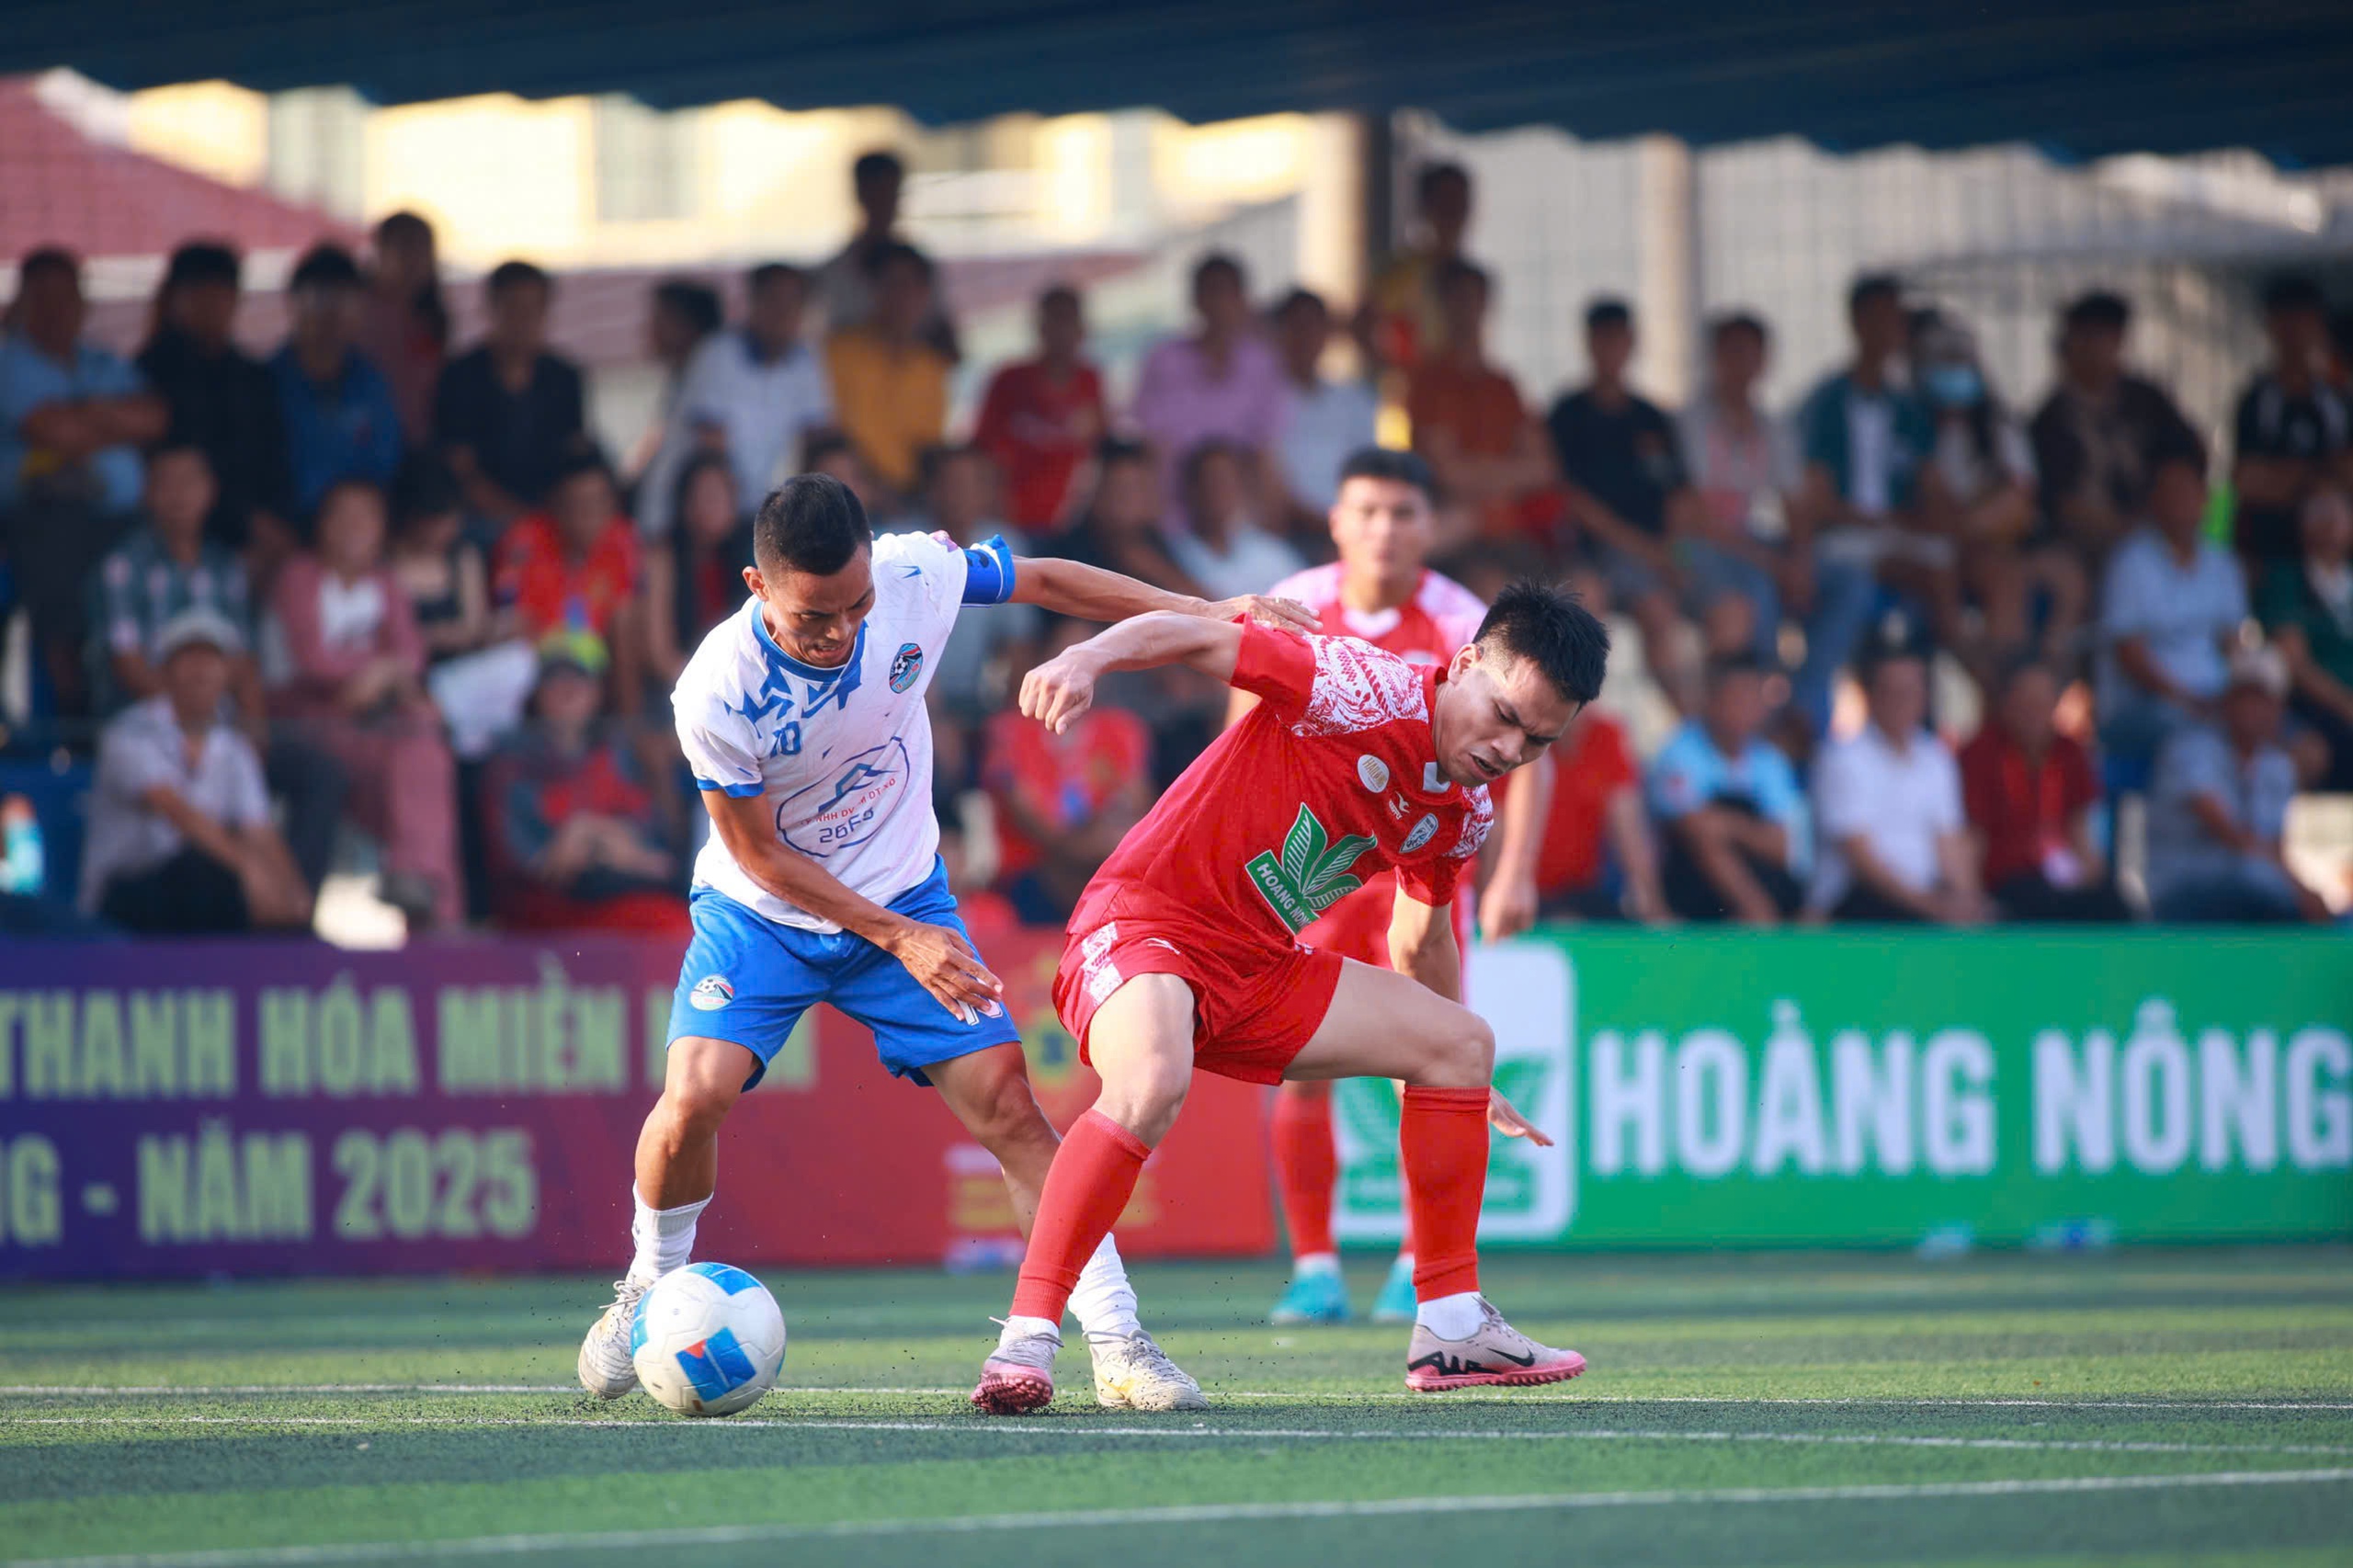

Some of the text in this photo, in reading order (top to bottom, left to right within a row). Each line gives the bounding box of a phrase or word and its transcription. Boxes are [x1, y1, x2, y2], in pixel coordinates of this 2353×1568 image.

[1256, 862, 1313, 927] HOANG NON
[260, 969, 420, 1097] HÓA
[1588, 998, 2353, 1176] HOÀNG NÔNG
[139, 1114, 313, 1244] NĂM
[334, 1129, 540, 1242] 2025
